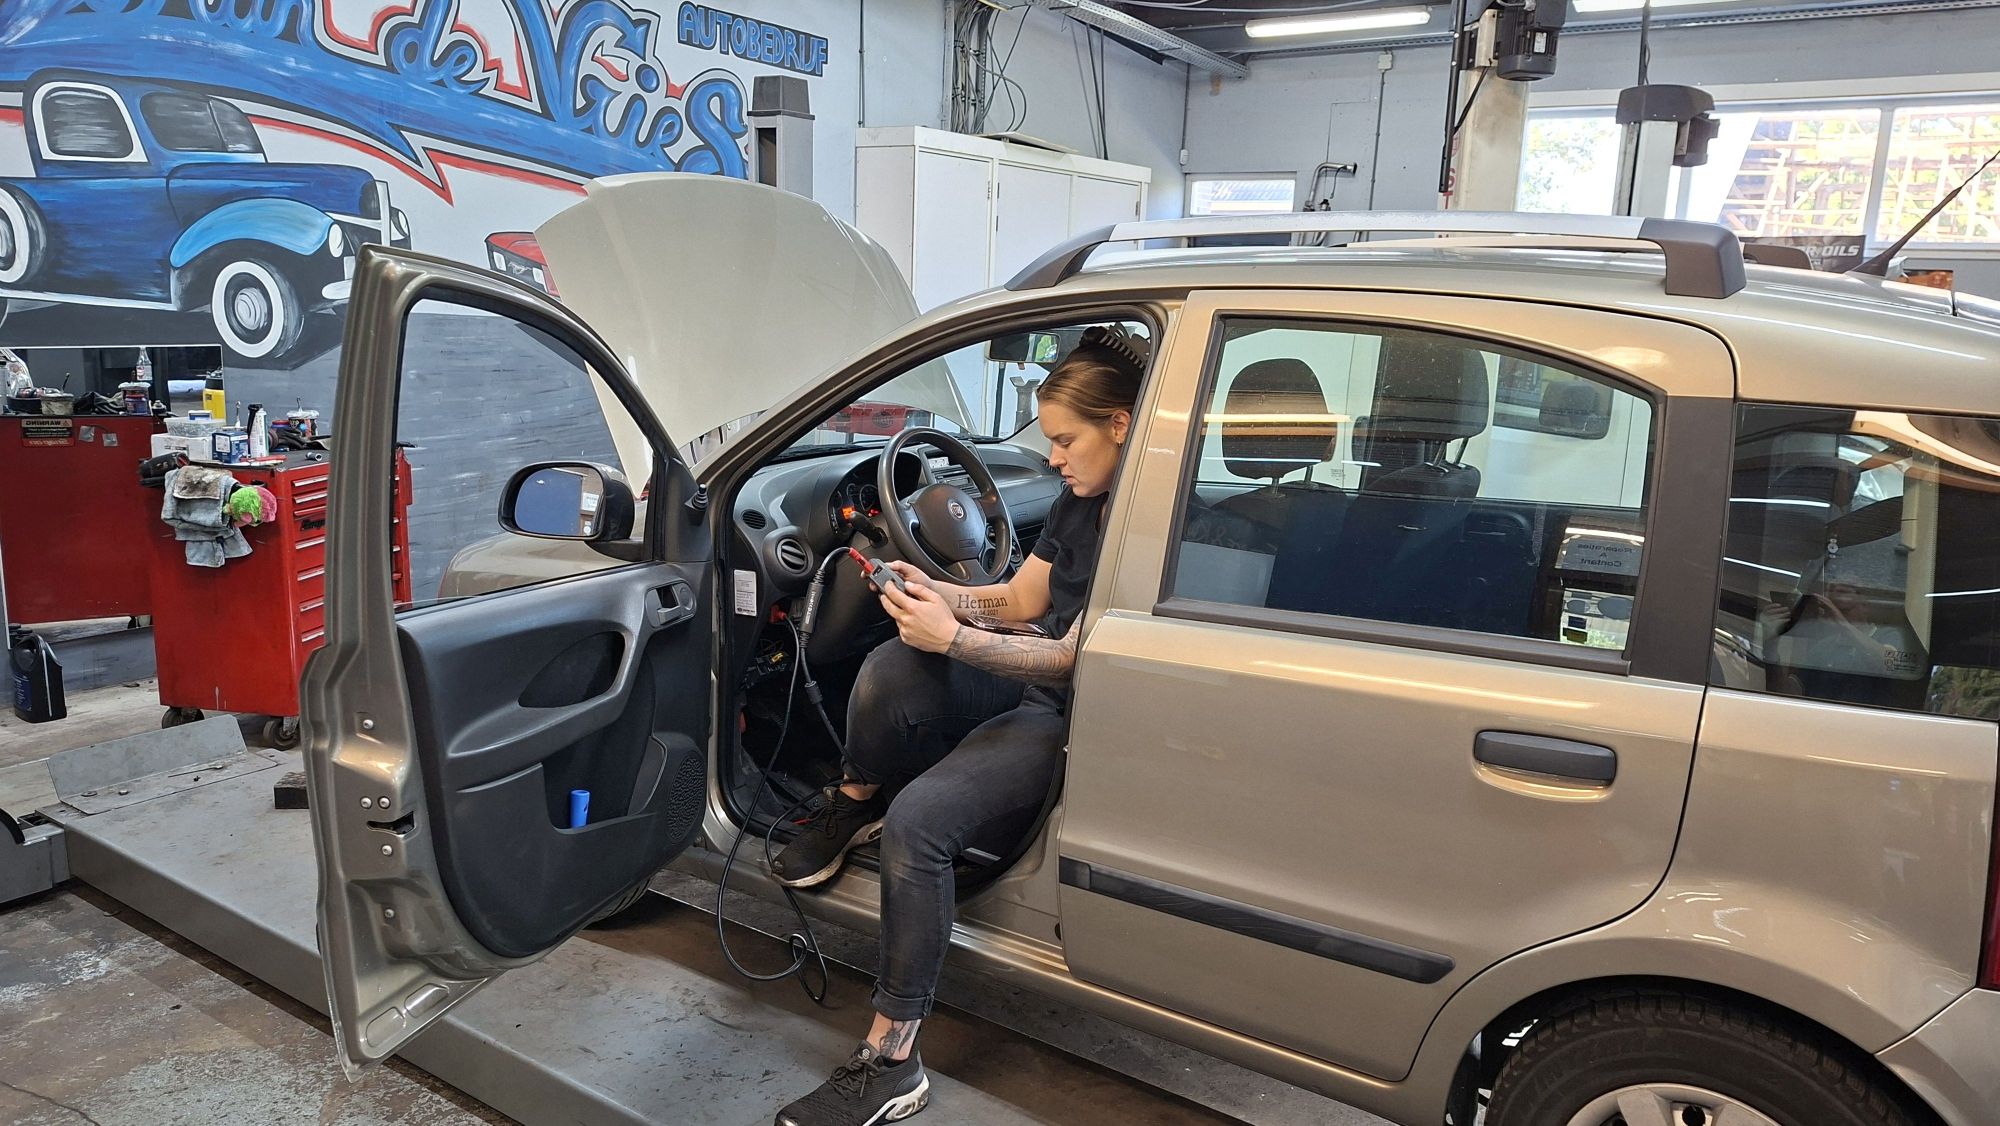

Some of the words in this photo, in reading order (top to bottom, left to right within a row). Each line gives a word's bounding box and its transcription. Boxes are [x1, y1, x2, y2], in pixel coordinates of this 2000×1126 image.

[391, 0, 489, 95] de
[680, 2, 828, 75] AUTOBEDRIJF
[1822, 245, 1860, 256] OILS
[956, 594, 1008, 608] Herman
